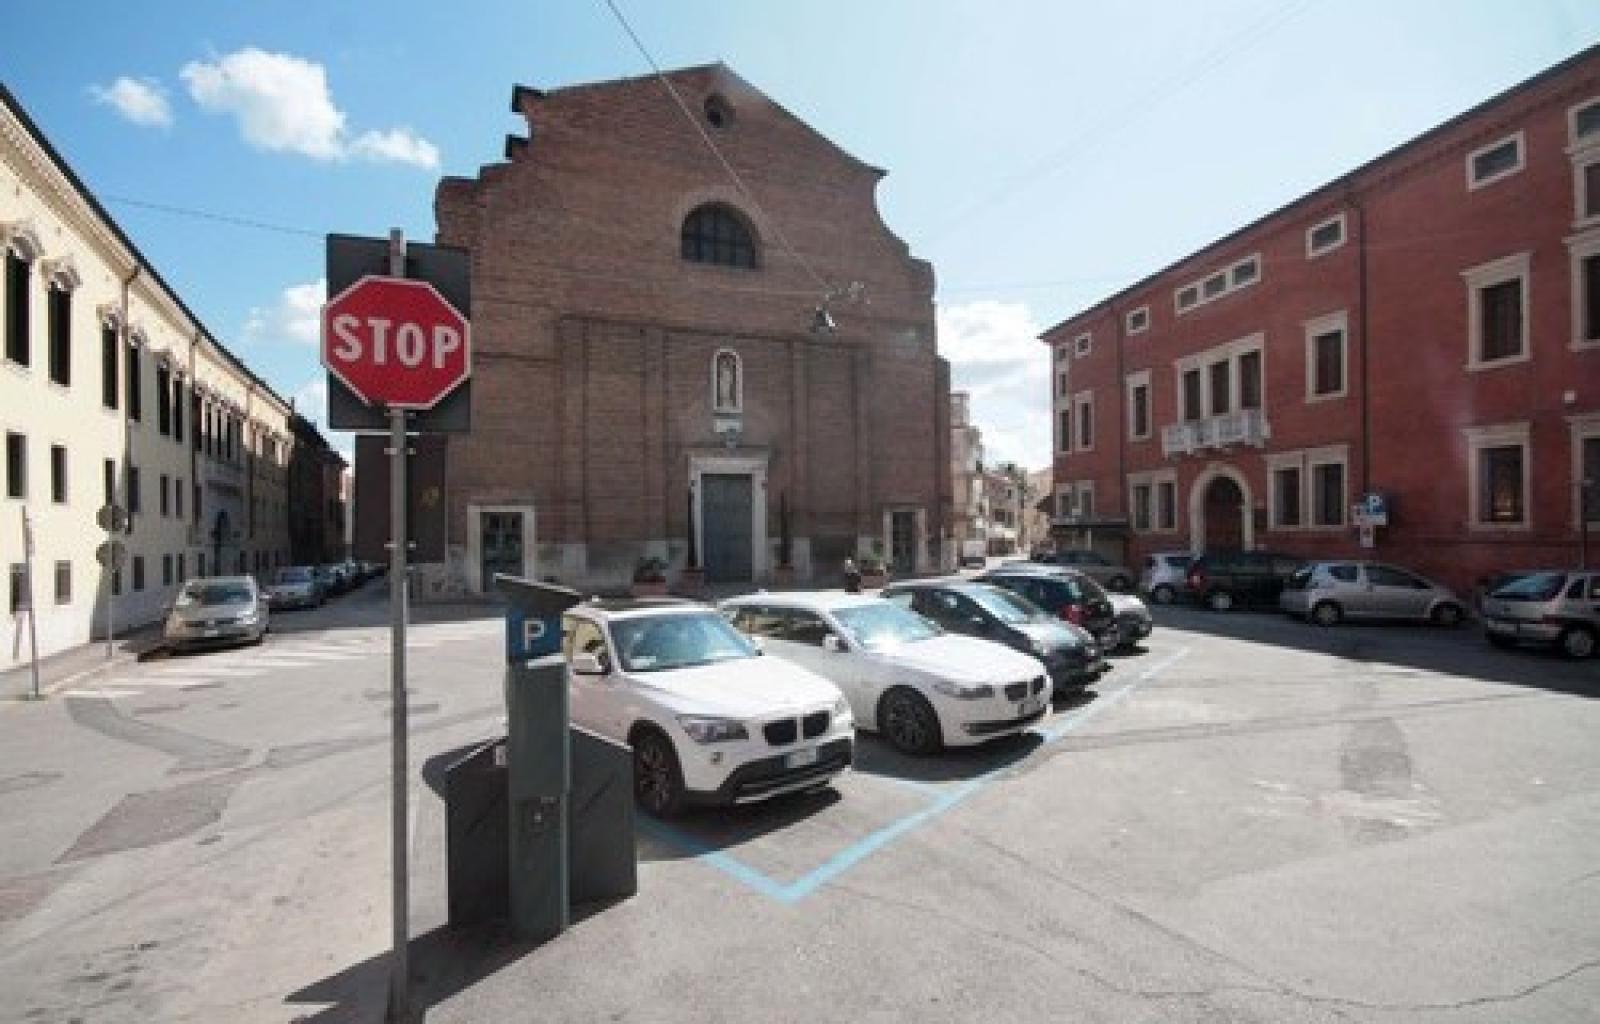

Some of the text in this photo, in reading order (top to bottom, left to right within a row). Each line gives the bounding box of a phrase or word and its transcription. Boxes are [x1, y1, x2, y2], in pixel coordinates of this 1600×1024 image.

[332, 313, 461, 369] STOP
[1369, 495, 1382, 512] P
[524, 619, 545, 650] P
